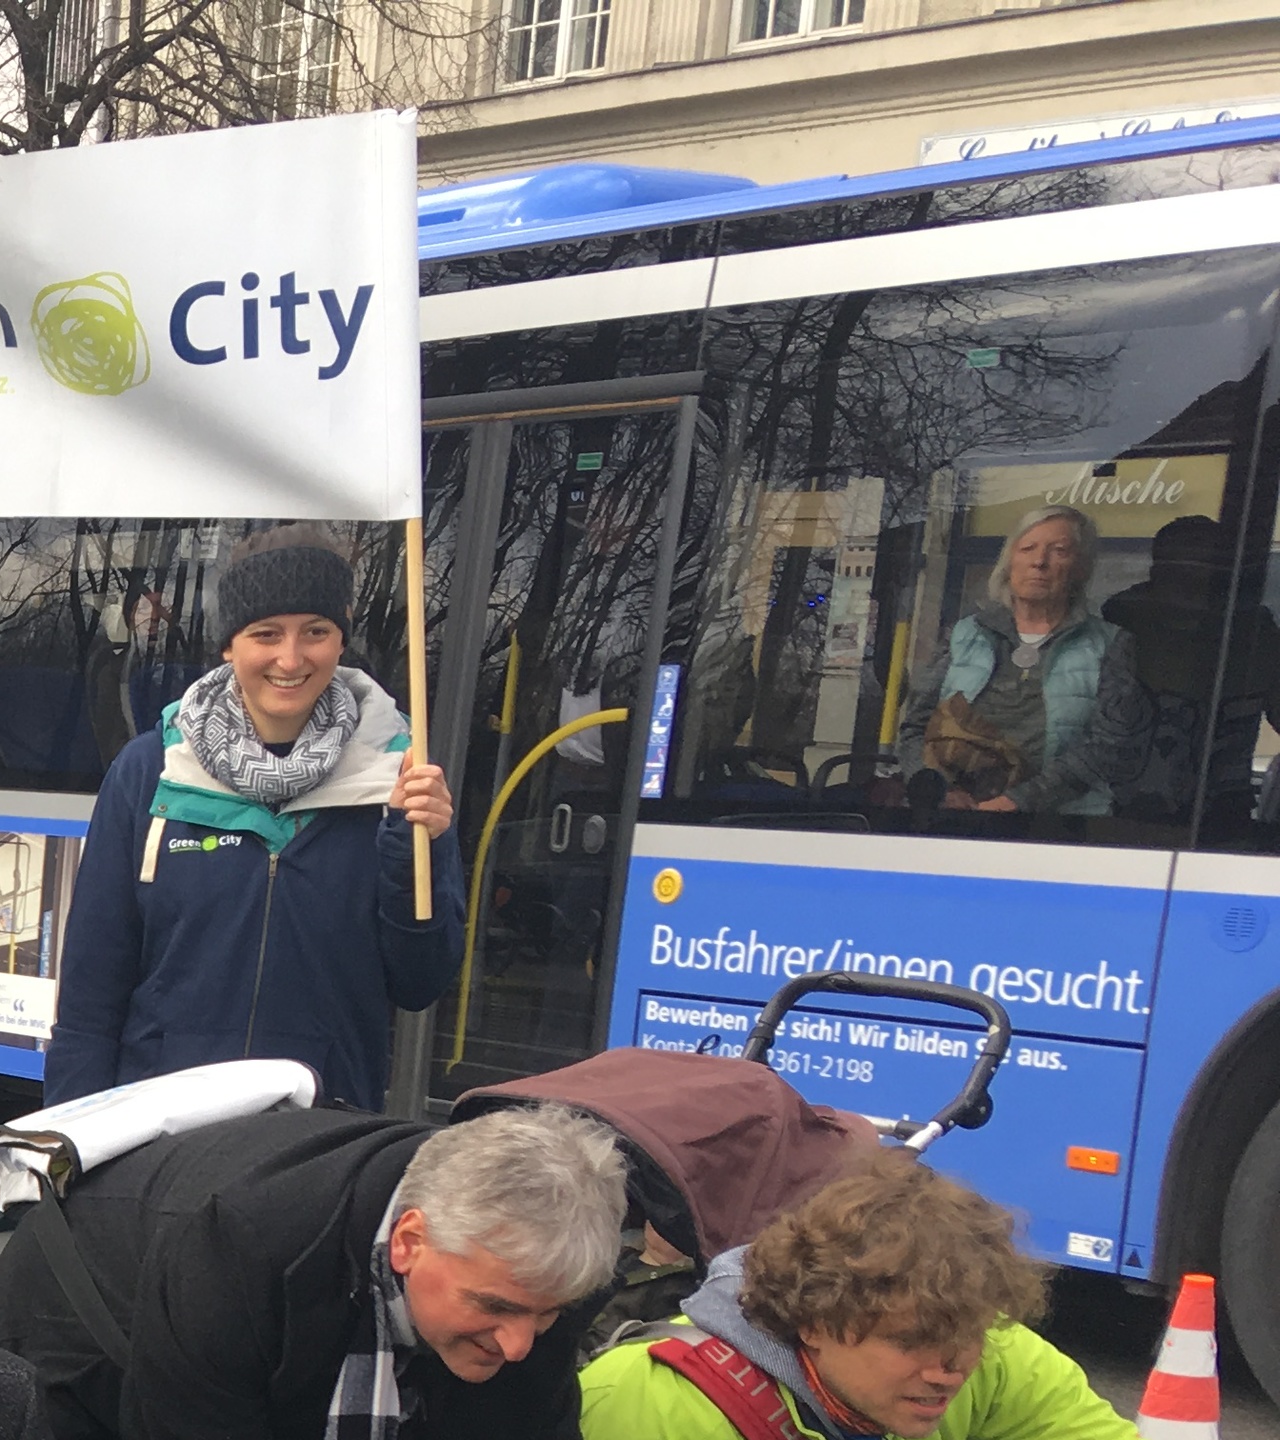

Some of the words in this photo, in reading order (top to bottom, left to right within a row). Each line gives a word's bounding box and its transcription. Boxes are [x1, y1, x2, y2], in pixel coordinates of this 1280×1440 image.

[169, 270, 376, 381] City
[168, 838, 202, 849] Green
[218, 834, 243, 847] City
[969, 960, 1151, 1015] gesucht.
[645, 1000, 749, 1032] Bewerben
[790, 1016, 842, 1043] sich!
[848, 1021, 891, 1048] Wir
[894, 1027, 968, 1059] bilden
[1017, 1047, 1069, 1072] aus.
